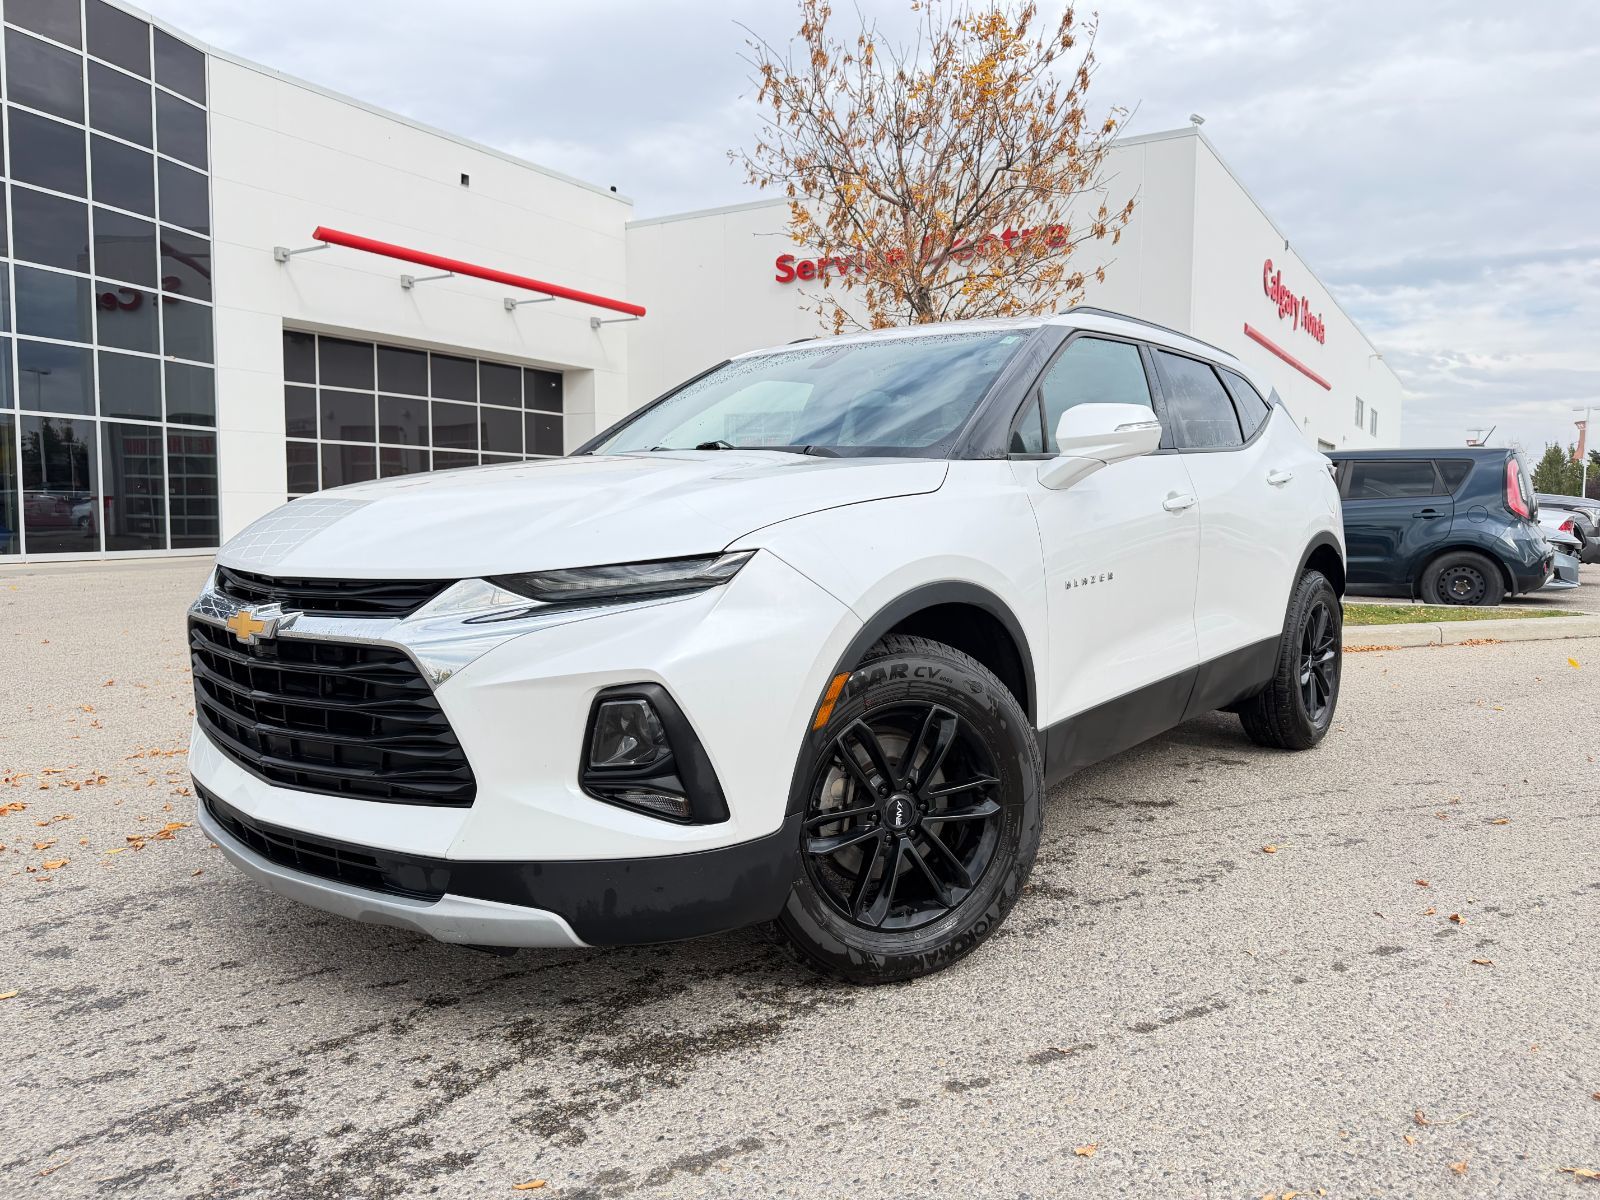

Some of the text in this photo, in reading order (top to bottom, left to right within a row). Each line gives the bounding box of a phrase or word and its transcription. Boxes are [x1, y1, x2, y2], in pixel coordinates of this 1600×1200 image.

[775, 242, 905, 283] Servie
[1263, 258, 1325, 344] Calgary Honda
[1064, 572, 1114, 590] BLAZER
